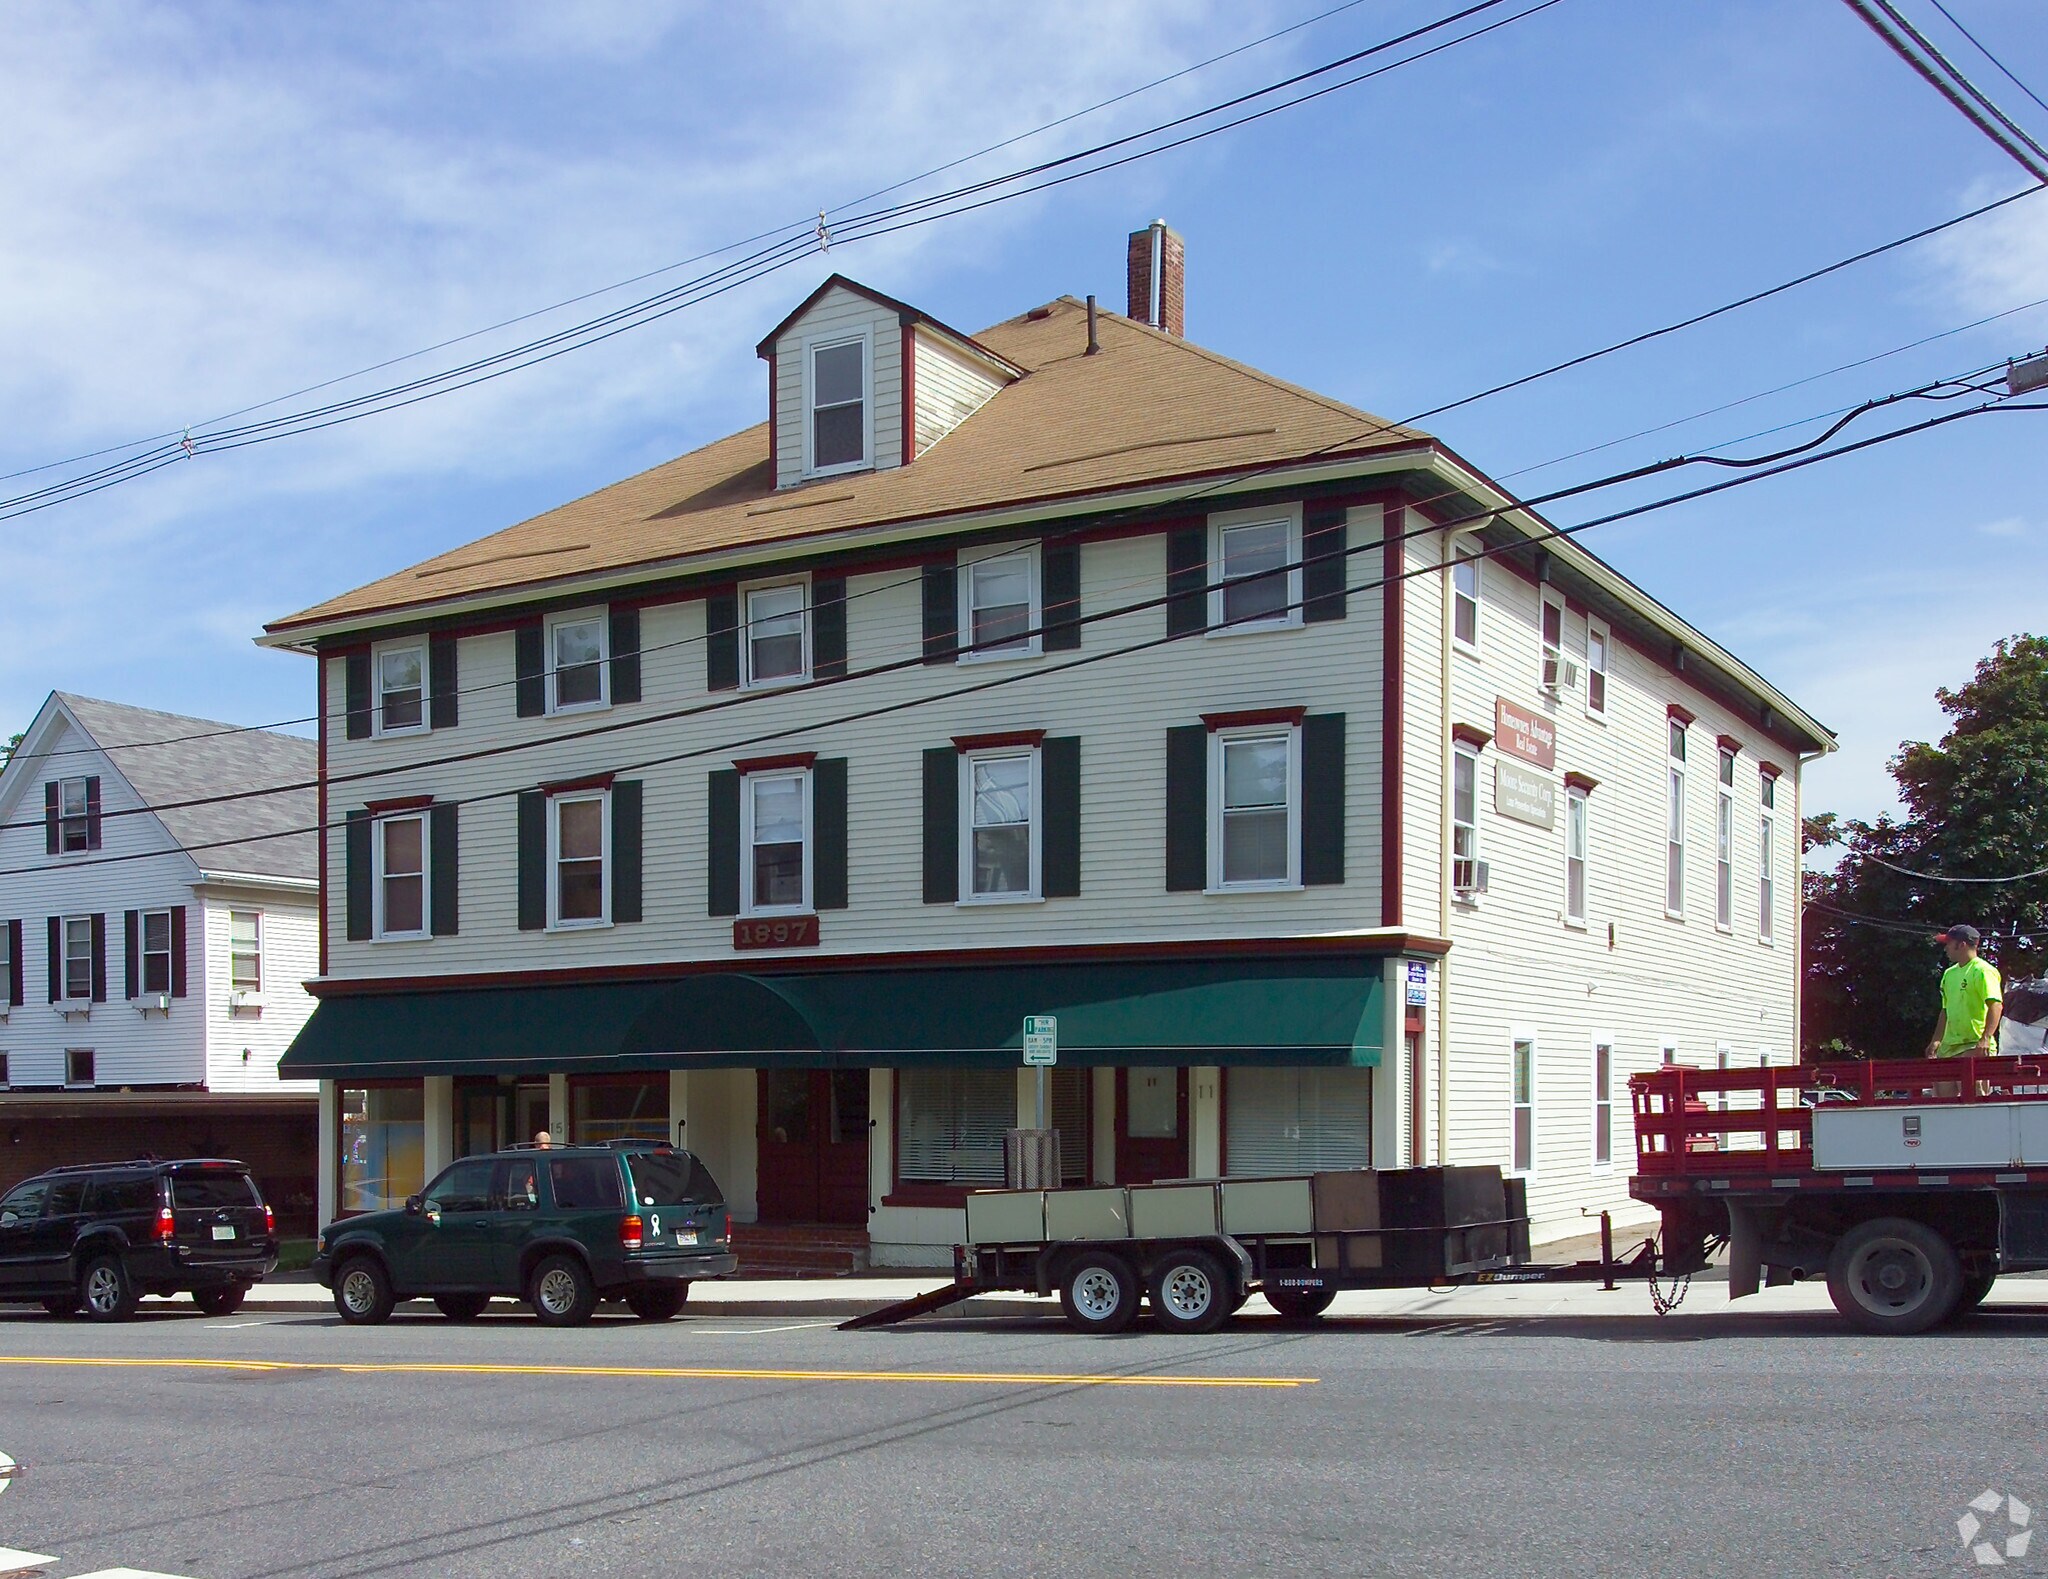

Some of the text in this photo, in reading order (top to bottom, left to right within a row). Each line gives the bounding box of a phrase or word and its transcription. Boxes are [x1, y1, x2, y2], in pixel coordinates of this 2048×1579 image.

[1518, 775, 1538, 803] Security
[741, 921, 808, 945] 1897
[550, 1122, 563, 1135] 15
